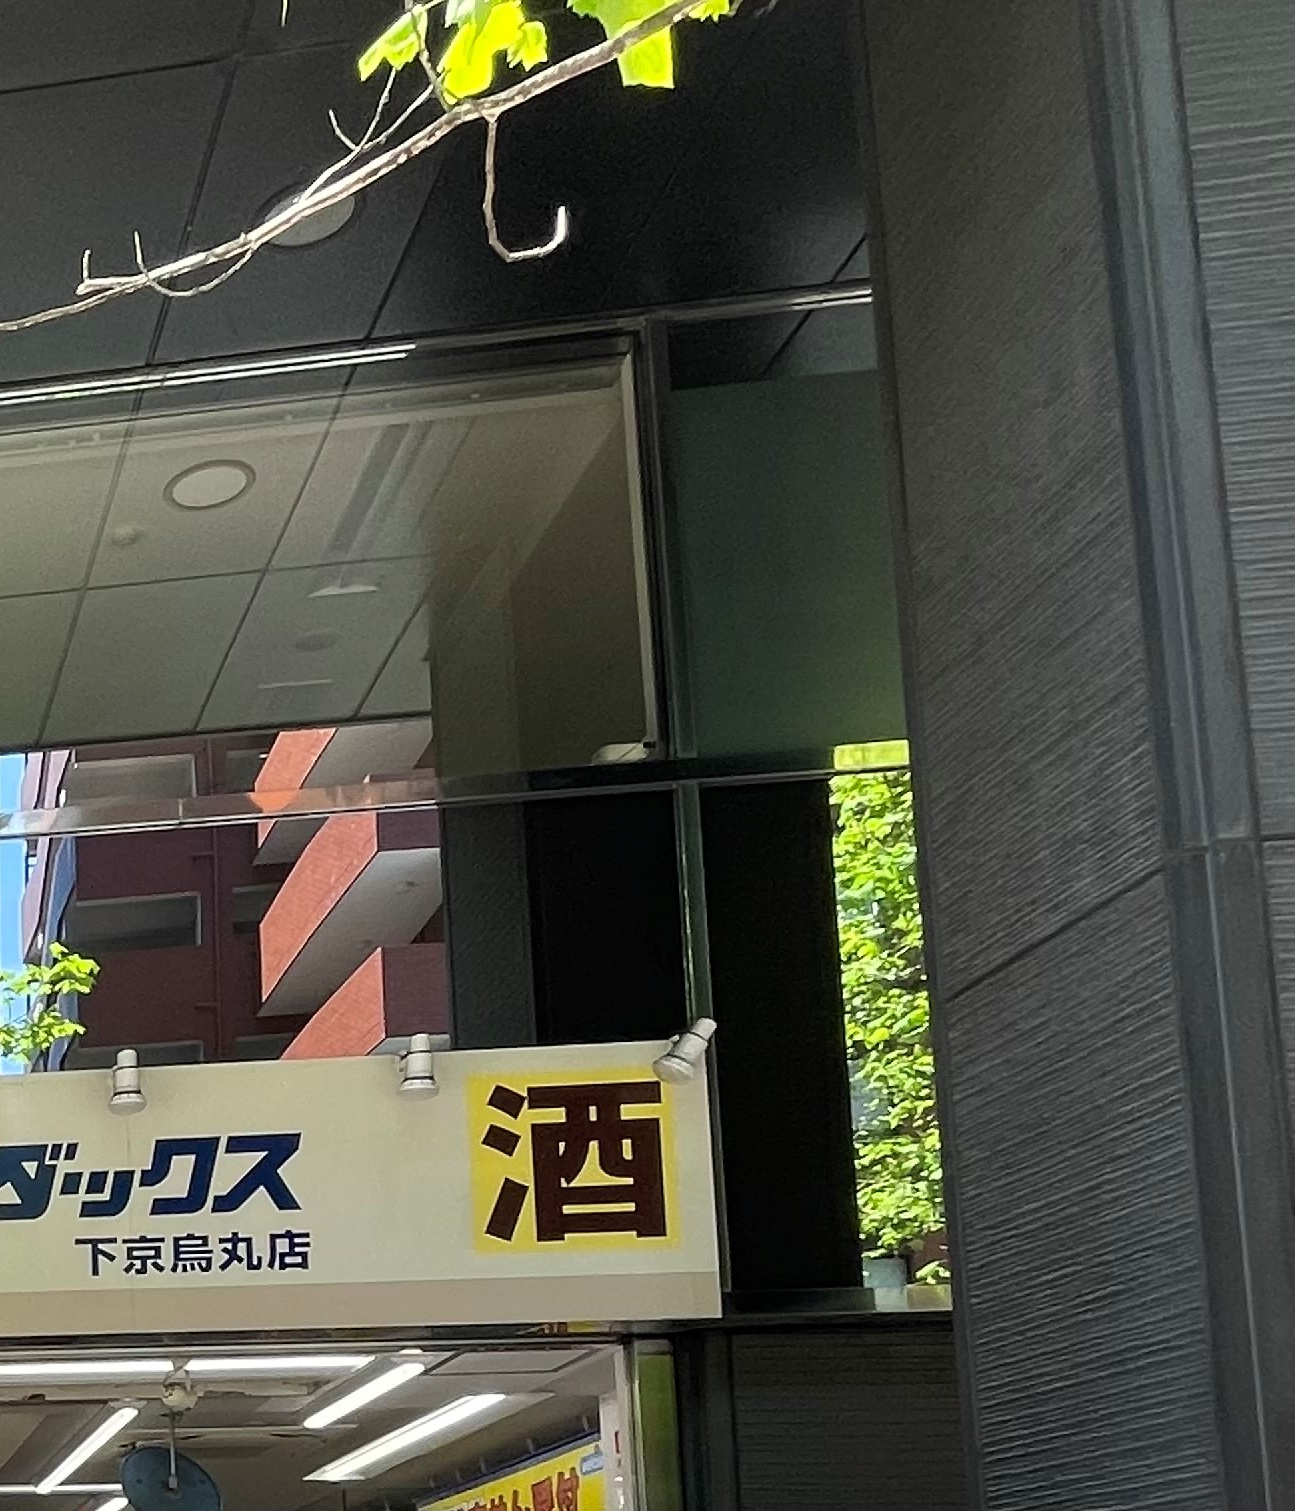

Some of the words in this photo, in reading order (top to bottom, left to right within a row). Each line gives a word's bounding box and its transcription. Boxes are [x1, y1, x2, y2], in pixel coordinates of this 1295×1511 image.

[481, 1081, 667, 1242] 酒
[74, 1230, 312, 1277] 下京烏丸店
